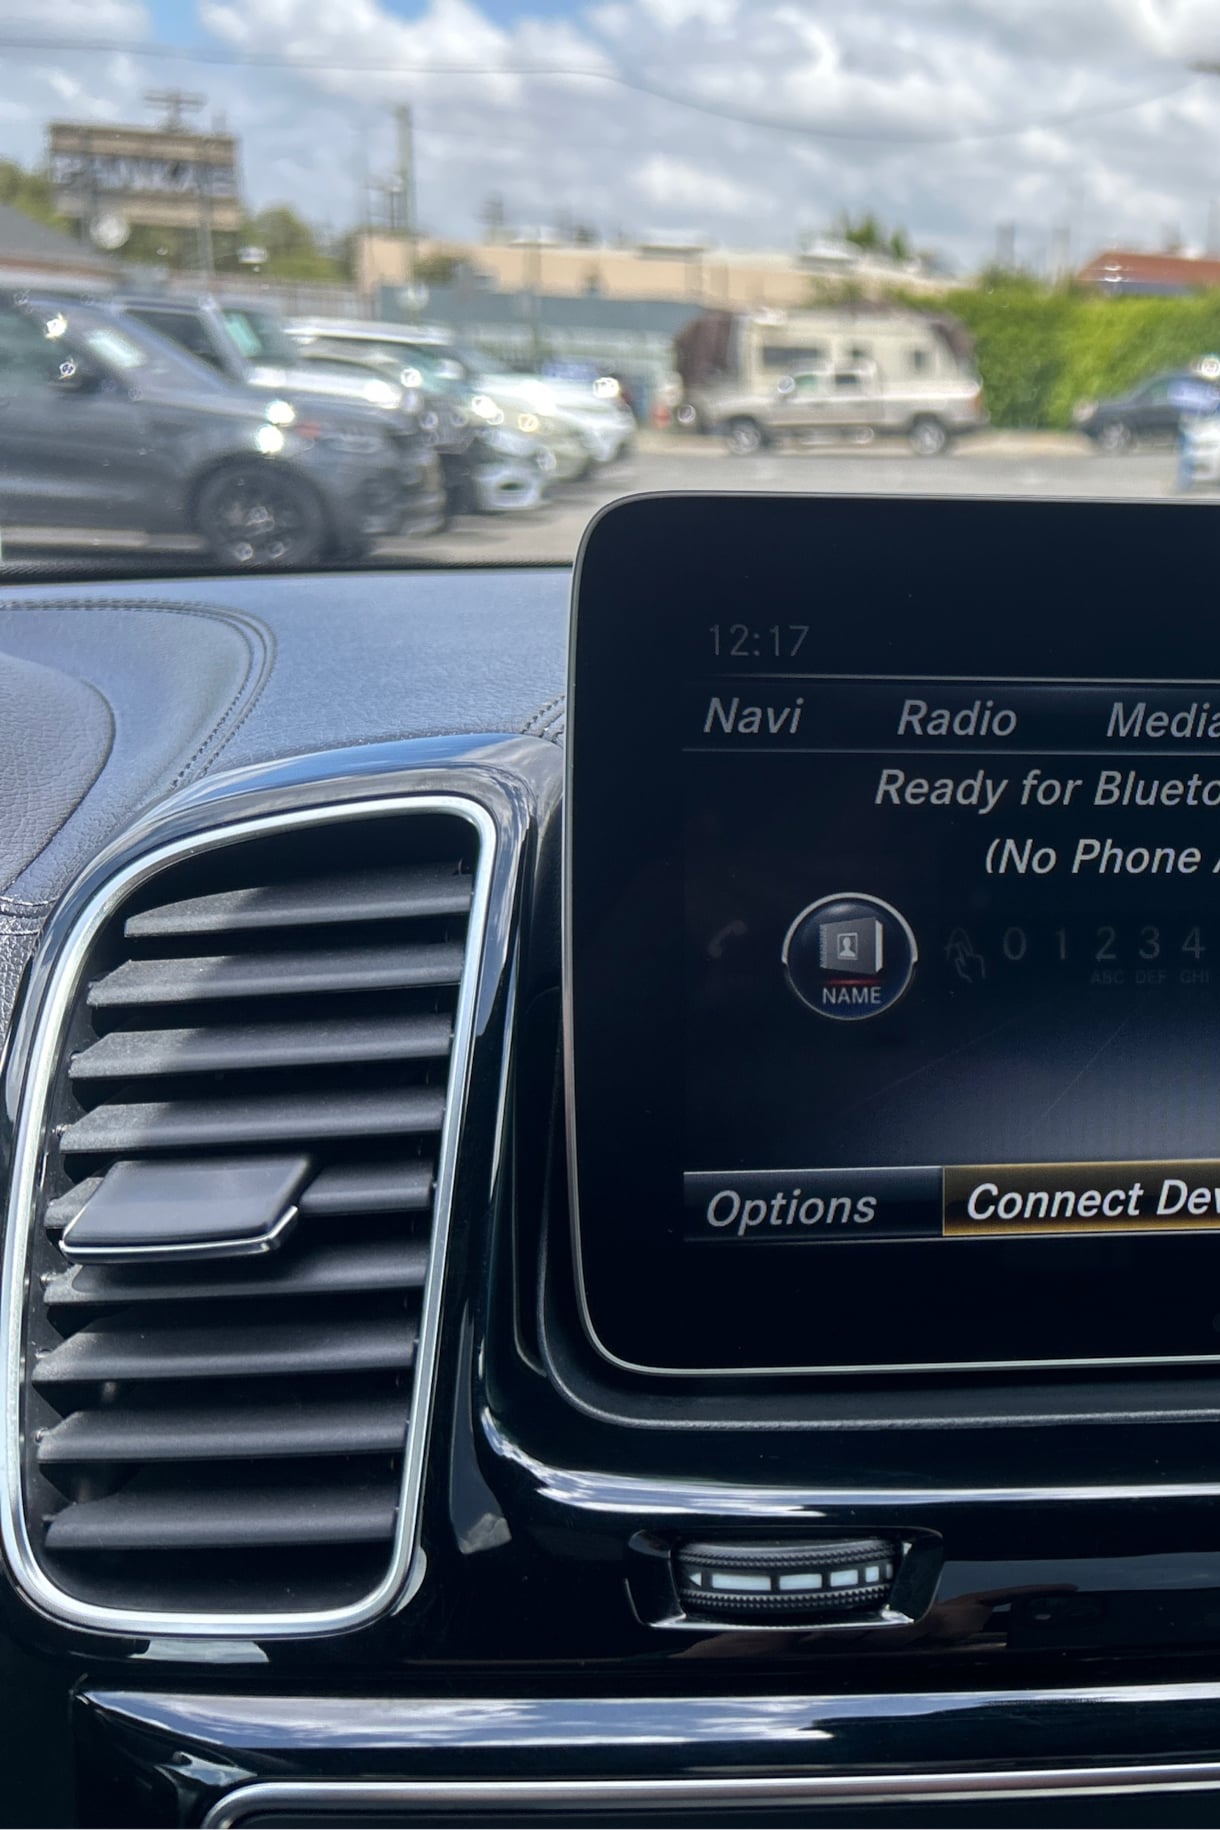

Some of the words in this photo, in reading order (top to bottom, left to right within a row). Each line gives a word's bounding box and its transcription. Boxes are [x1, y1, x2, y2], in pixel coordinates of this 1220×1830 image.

[707, 623, 810, 657] 12:17
[703, 697, 803, 734] Navi
[897, 699, 1018, 736] Radio
[874, 769, 1008, 814] Ready
[1020, 769, 1083, 806] for
[984, 839, 1057, 874] (No
[1071, 838, 1202, 874] Phone
[1090, 967, 1126, 984] ABC
[1135, 967, 1168, 984] DEF
[1179, 967, 1210, 984] GHI
[820, 986, 881, 1007] NAME
[705, 1187, 879, 1238] Options
[966, 1181, 1145, 1221] Connect
